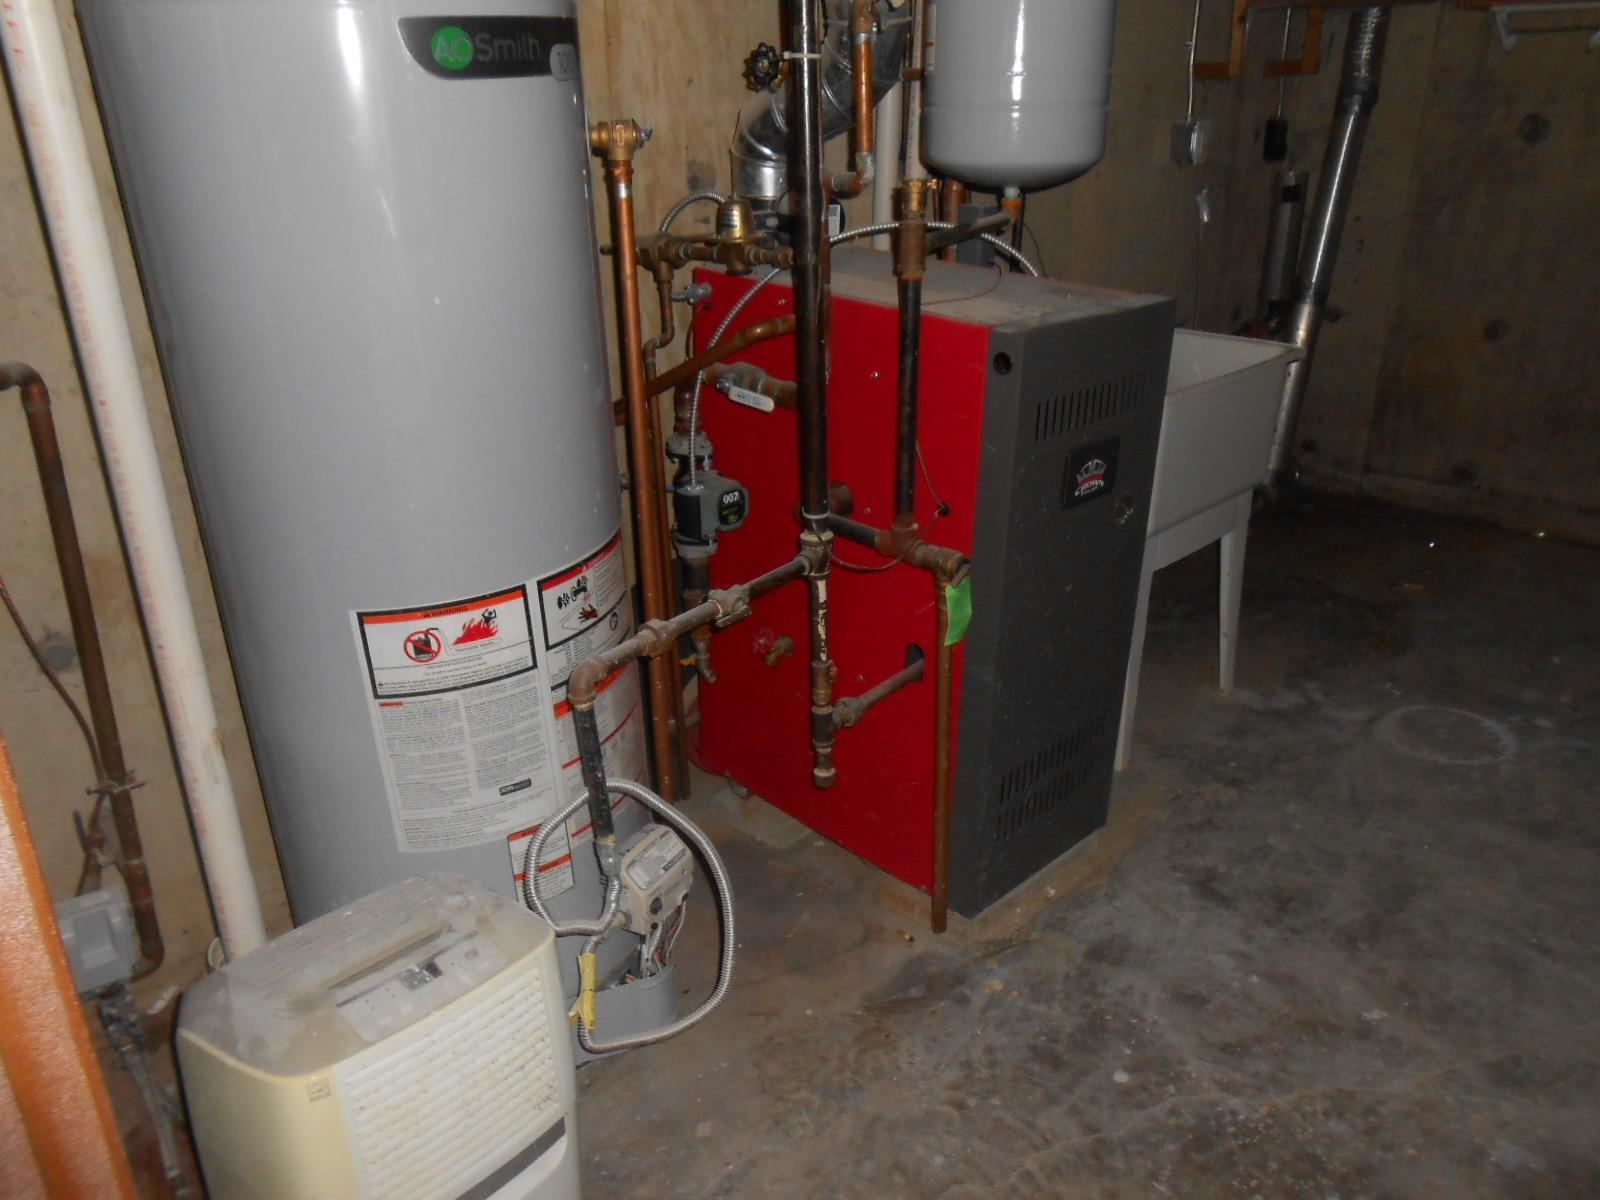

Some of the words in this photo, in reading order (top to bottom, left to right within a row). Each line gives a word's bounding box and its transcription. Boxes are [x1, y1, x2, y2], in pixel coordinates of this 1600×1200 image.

[1074, 479, 1106, 497] CROWN
[723, 491, 740, 504] 007
[431, 605, 469, 617] WARNING
